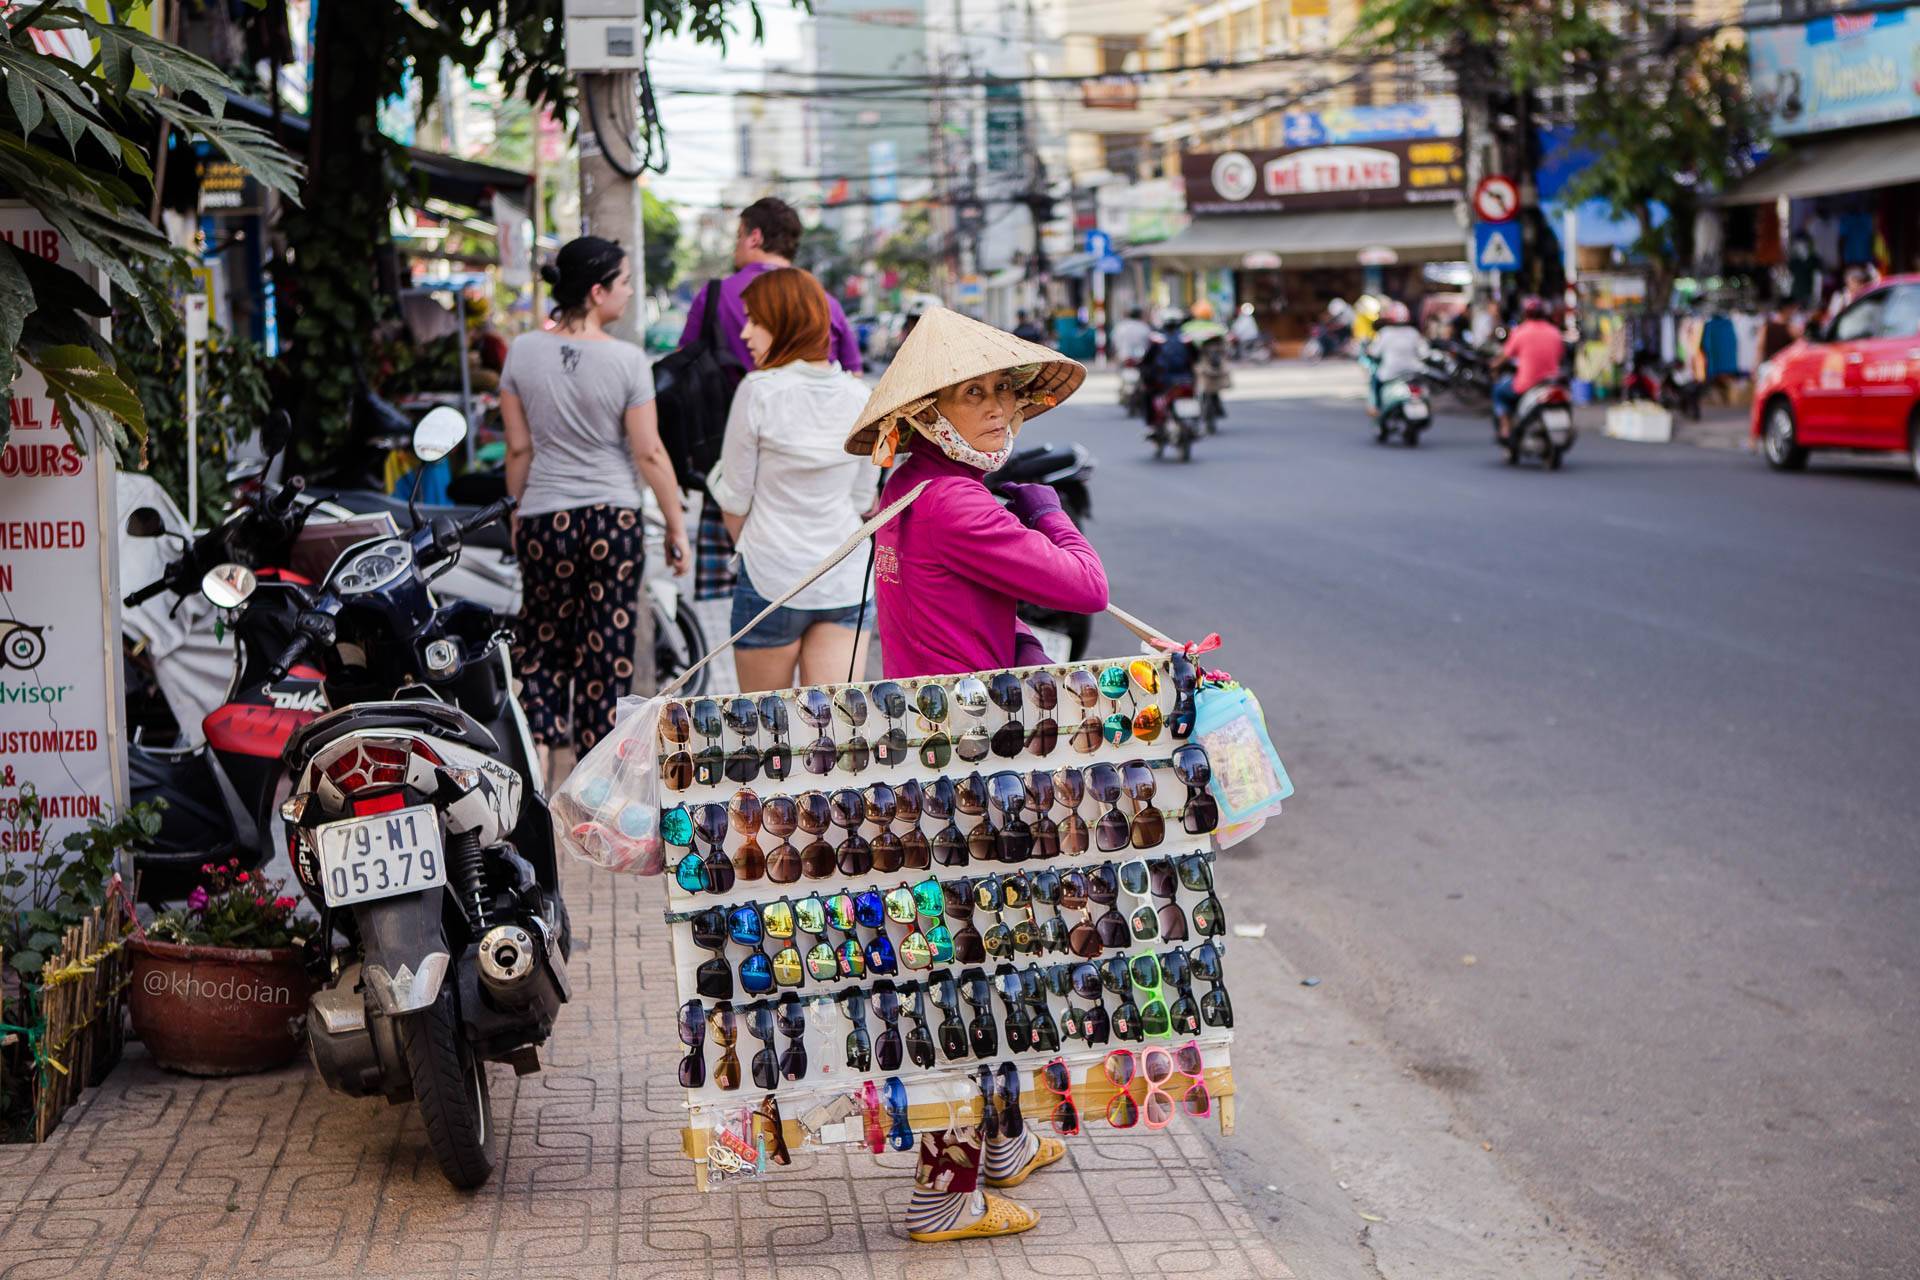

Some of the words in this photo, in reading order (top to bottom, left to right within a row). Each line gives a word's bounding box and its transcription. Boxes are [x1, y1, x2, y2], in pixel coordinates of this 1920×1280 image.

[4, 764, 16, 787] &
[0, 796, 100, 820] FOMATION
[338, 815, 418, 861] 79-N1
[331, 849, 437, 898] 053.79
